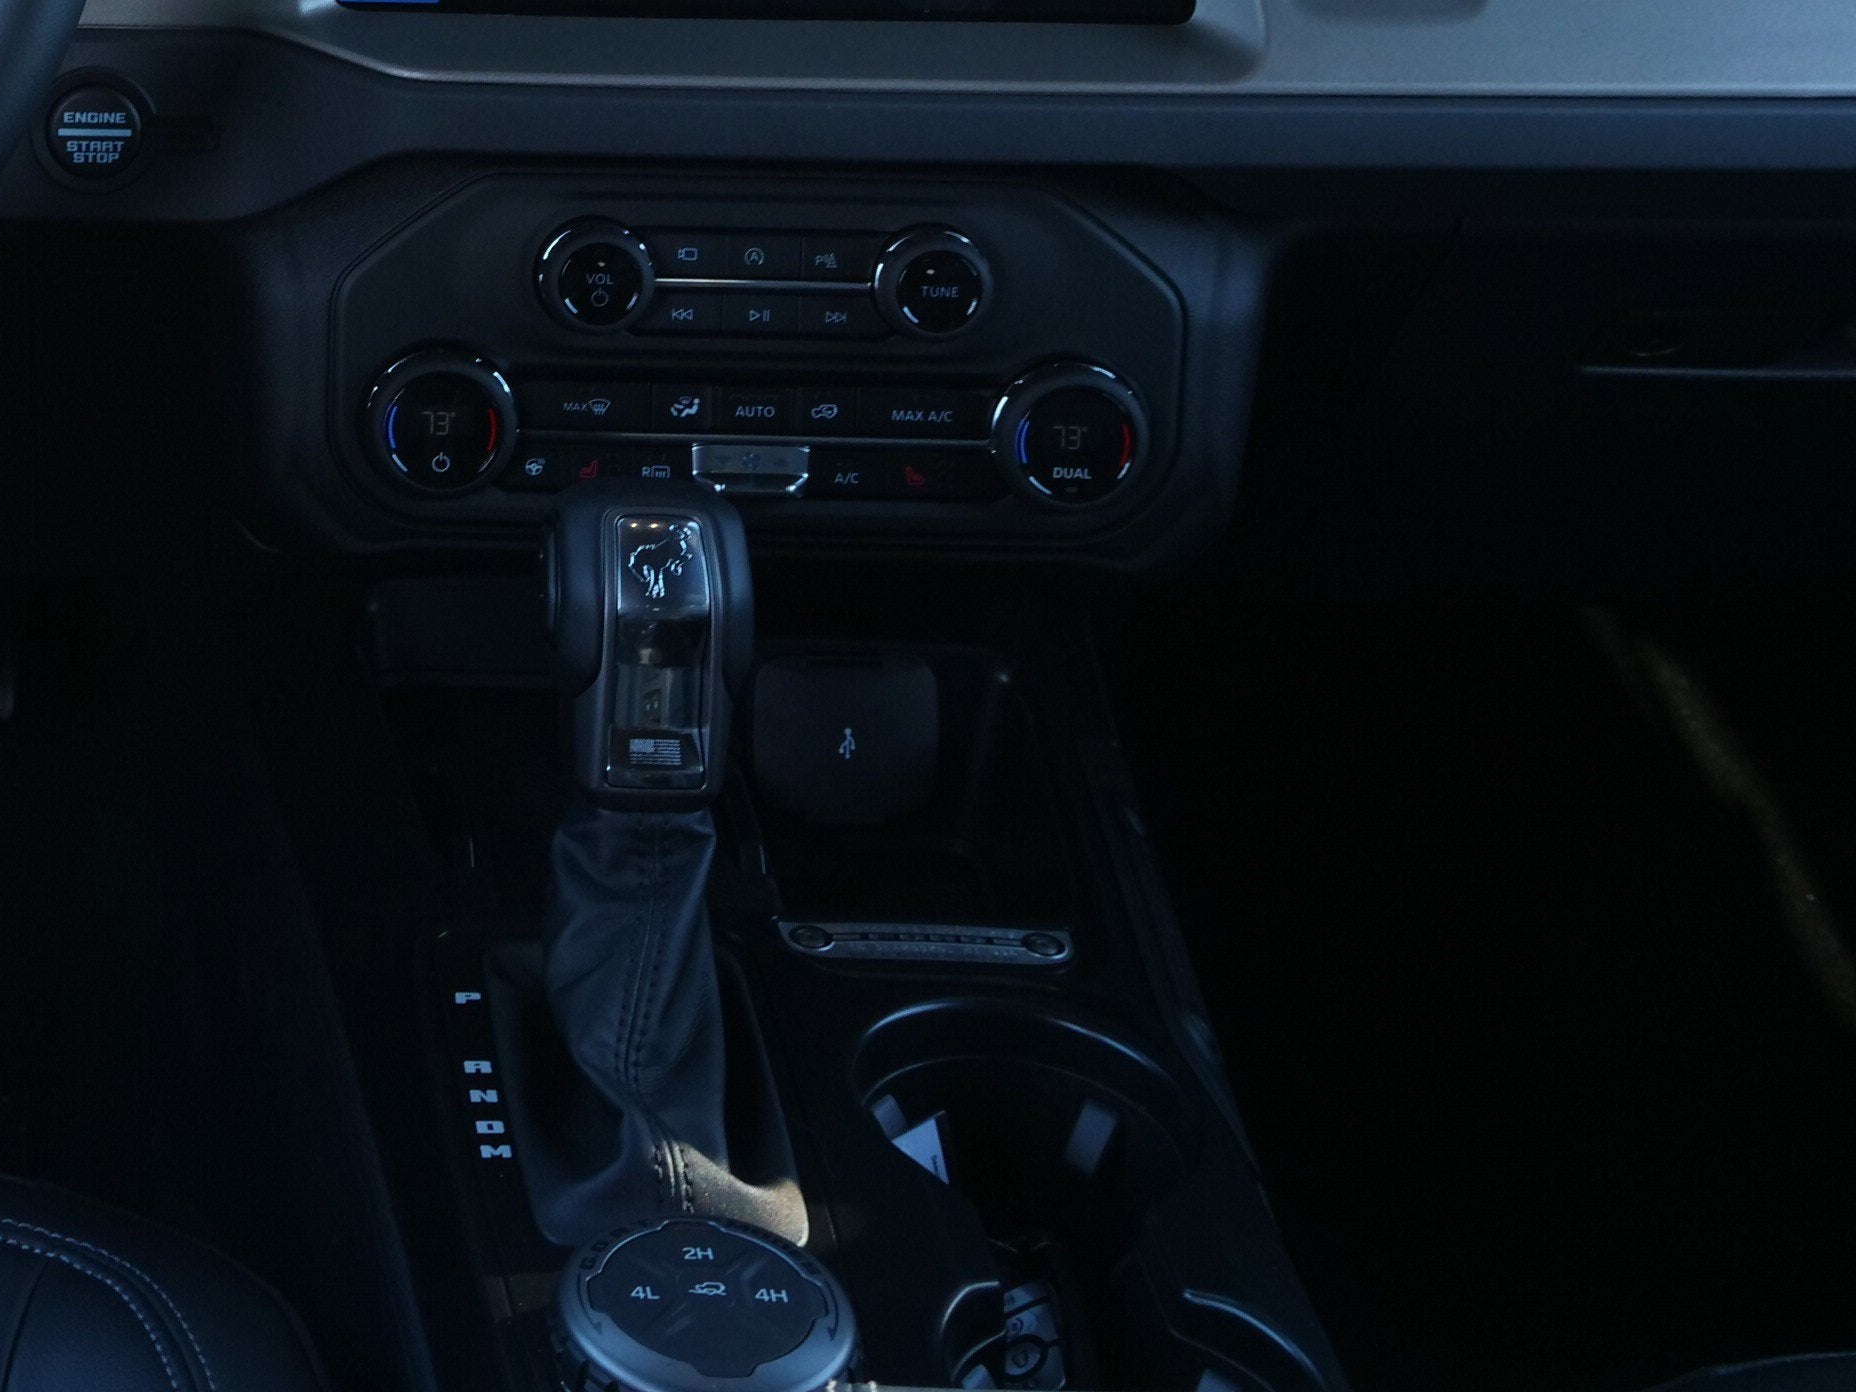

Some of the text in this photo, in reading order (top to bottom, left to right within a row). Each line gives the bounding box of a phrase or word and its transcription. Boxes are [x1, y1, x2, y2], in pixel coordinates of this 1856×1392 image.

[63, 111, 126, 124] ENGINE
[66, 140, 124, 152] START
[72, 152, 120, 164] STOP
[585, 273, 614, 286] VOL
[920, 285, 960, 299] TUNE
[563, 402, 587, 412] MAX
[735, 405, 775, 419] AUTO
[891, 409, 953, 423] MAX A/C
[834, 472, 859, 484] A/C
[1052, 466, 1092, 480] DUAL
[454, 991, 482, 1004] P
[469, 1089, 499, 1104] N
[480, 1144, 513, 1159] M
[682, 1245, 715, 1261] 2H
[630, 1285, 661, 1300] 4L
[754, 1287, 789, 1303] 4H
